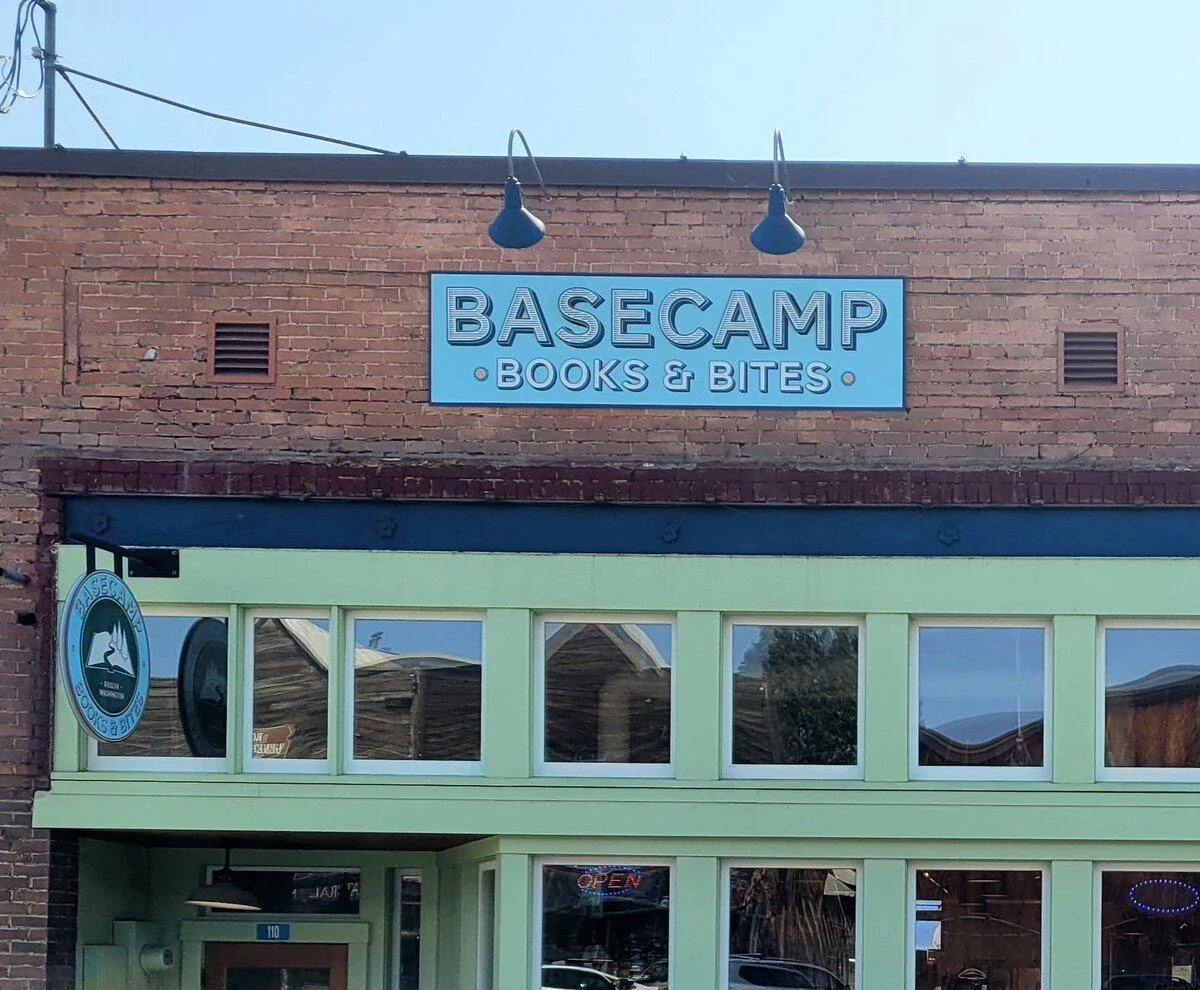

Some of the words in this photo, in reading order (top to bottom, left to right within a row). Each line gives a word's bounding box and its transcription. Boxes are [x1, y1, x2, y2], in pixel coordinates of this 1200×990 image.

[445, 286, 887, 350] BASECAMP
[496, 358, 648, 392] BOOKS
[663, 360, 695, 393] &
[708, 360, 832, 394] BITES
[75, 574, 143, 633] BASECAMP
[74, 681, 108, 734] BOOKS
[576, 872, 644, 889] OPEN
[267, 925, 280, 939] 110
